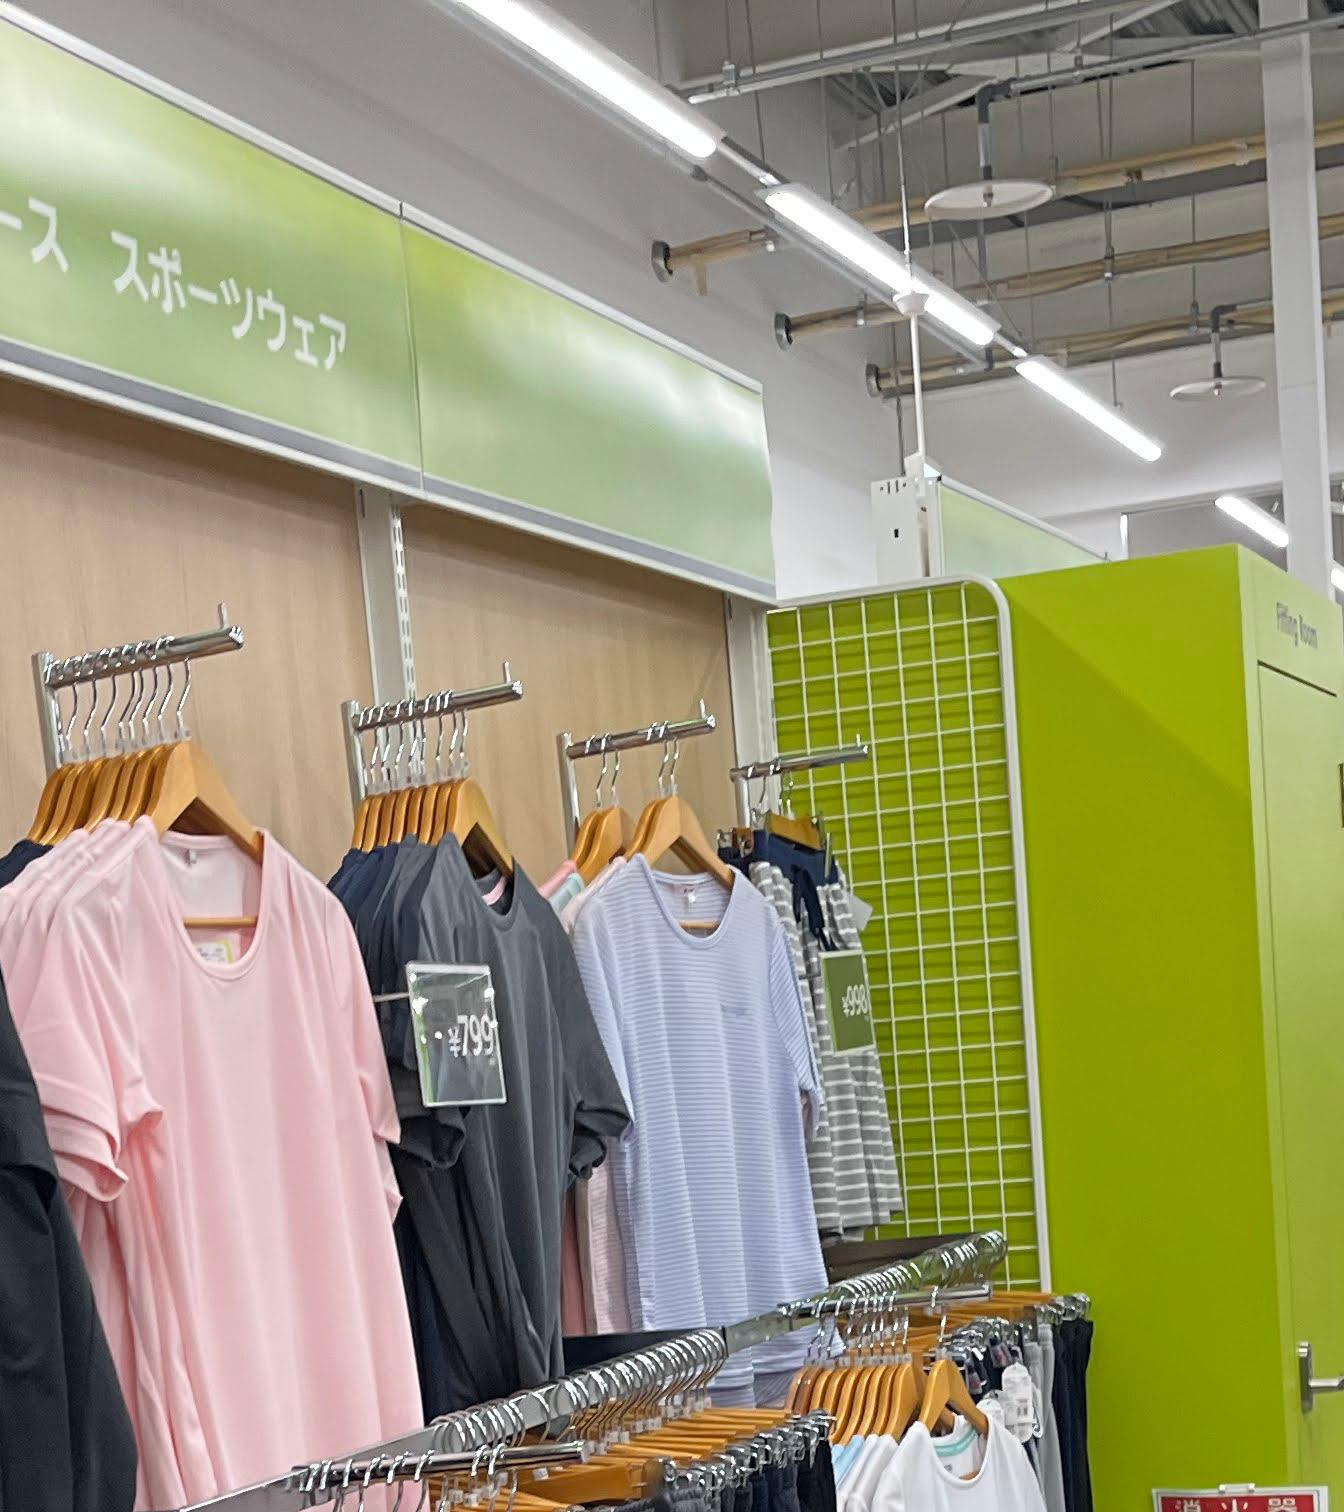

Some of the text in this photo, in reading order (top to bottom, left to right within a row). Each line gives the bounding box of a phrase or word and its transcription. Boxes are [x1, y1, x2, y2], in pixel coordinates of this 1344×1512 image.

[110, 229, 347, 371] スポーツウェア
[447, 1013, 494, 1058] ¥799
